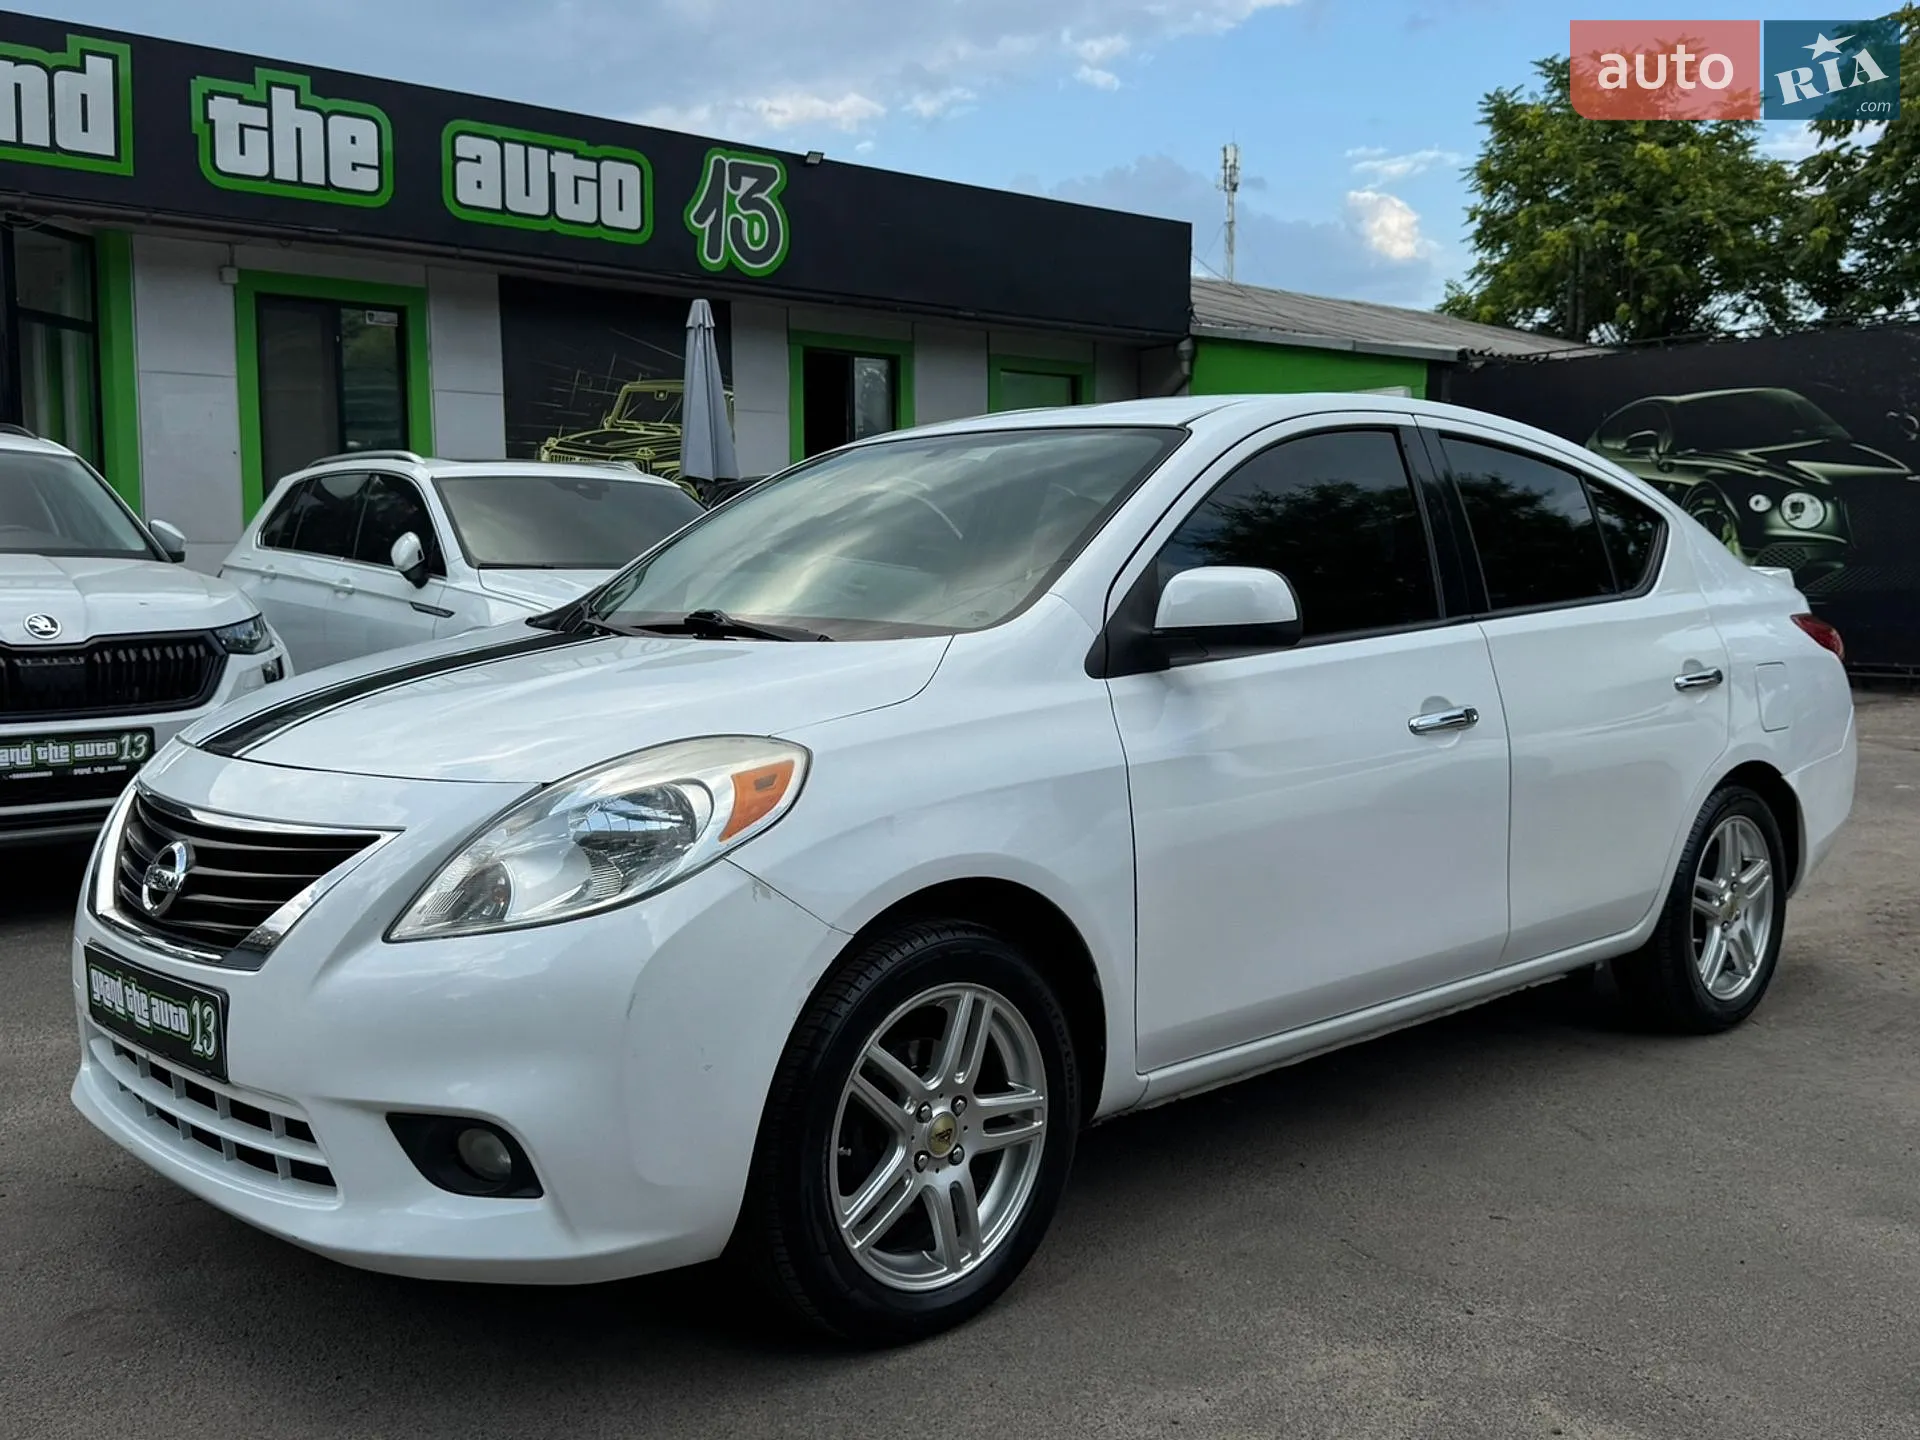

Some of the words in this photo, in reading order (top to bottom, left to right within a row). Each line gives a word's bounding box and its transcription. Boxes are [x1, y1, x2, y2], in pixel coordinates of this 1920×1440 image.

[208, 86, 380, 194] the
[454, 134, 643, 231] auto
[688, 154, 784, 268] 13
[36, 743, 70, 763] the
[74, 741, 117, 758] auto
[119, 733, 148, 761] 13
[124, 982, 151, 1028] the
[150, 997, 190, 1036] auto
[192, 999, 216, 1057] 13
